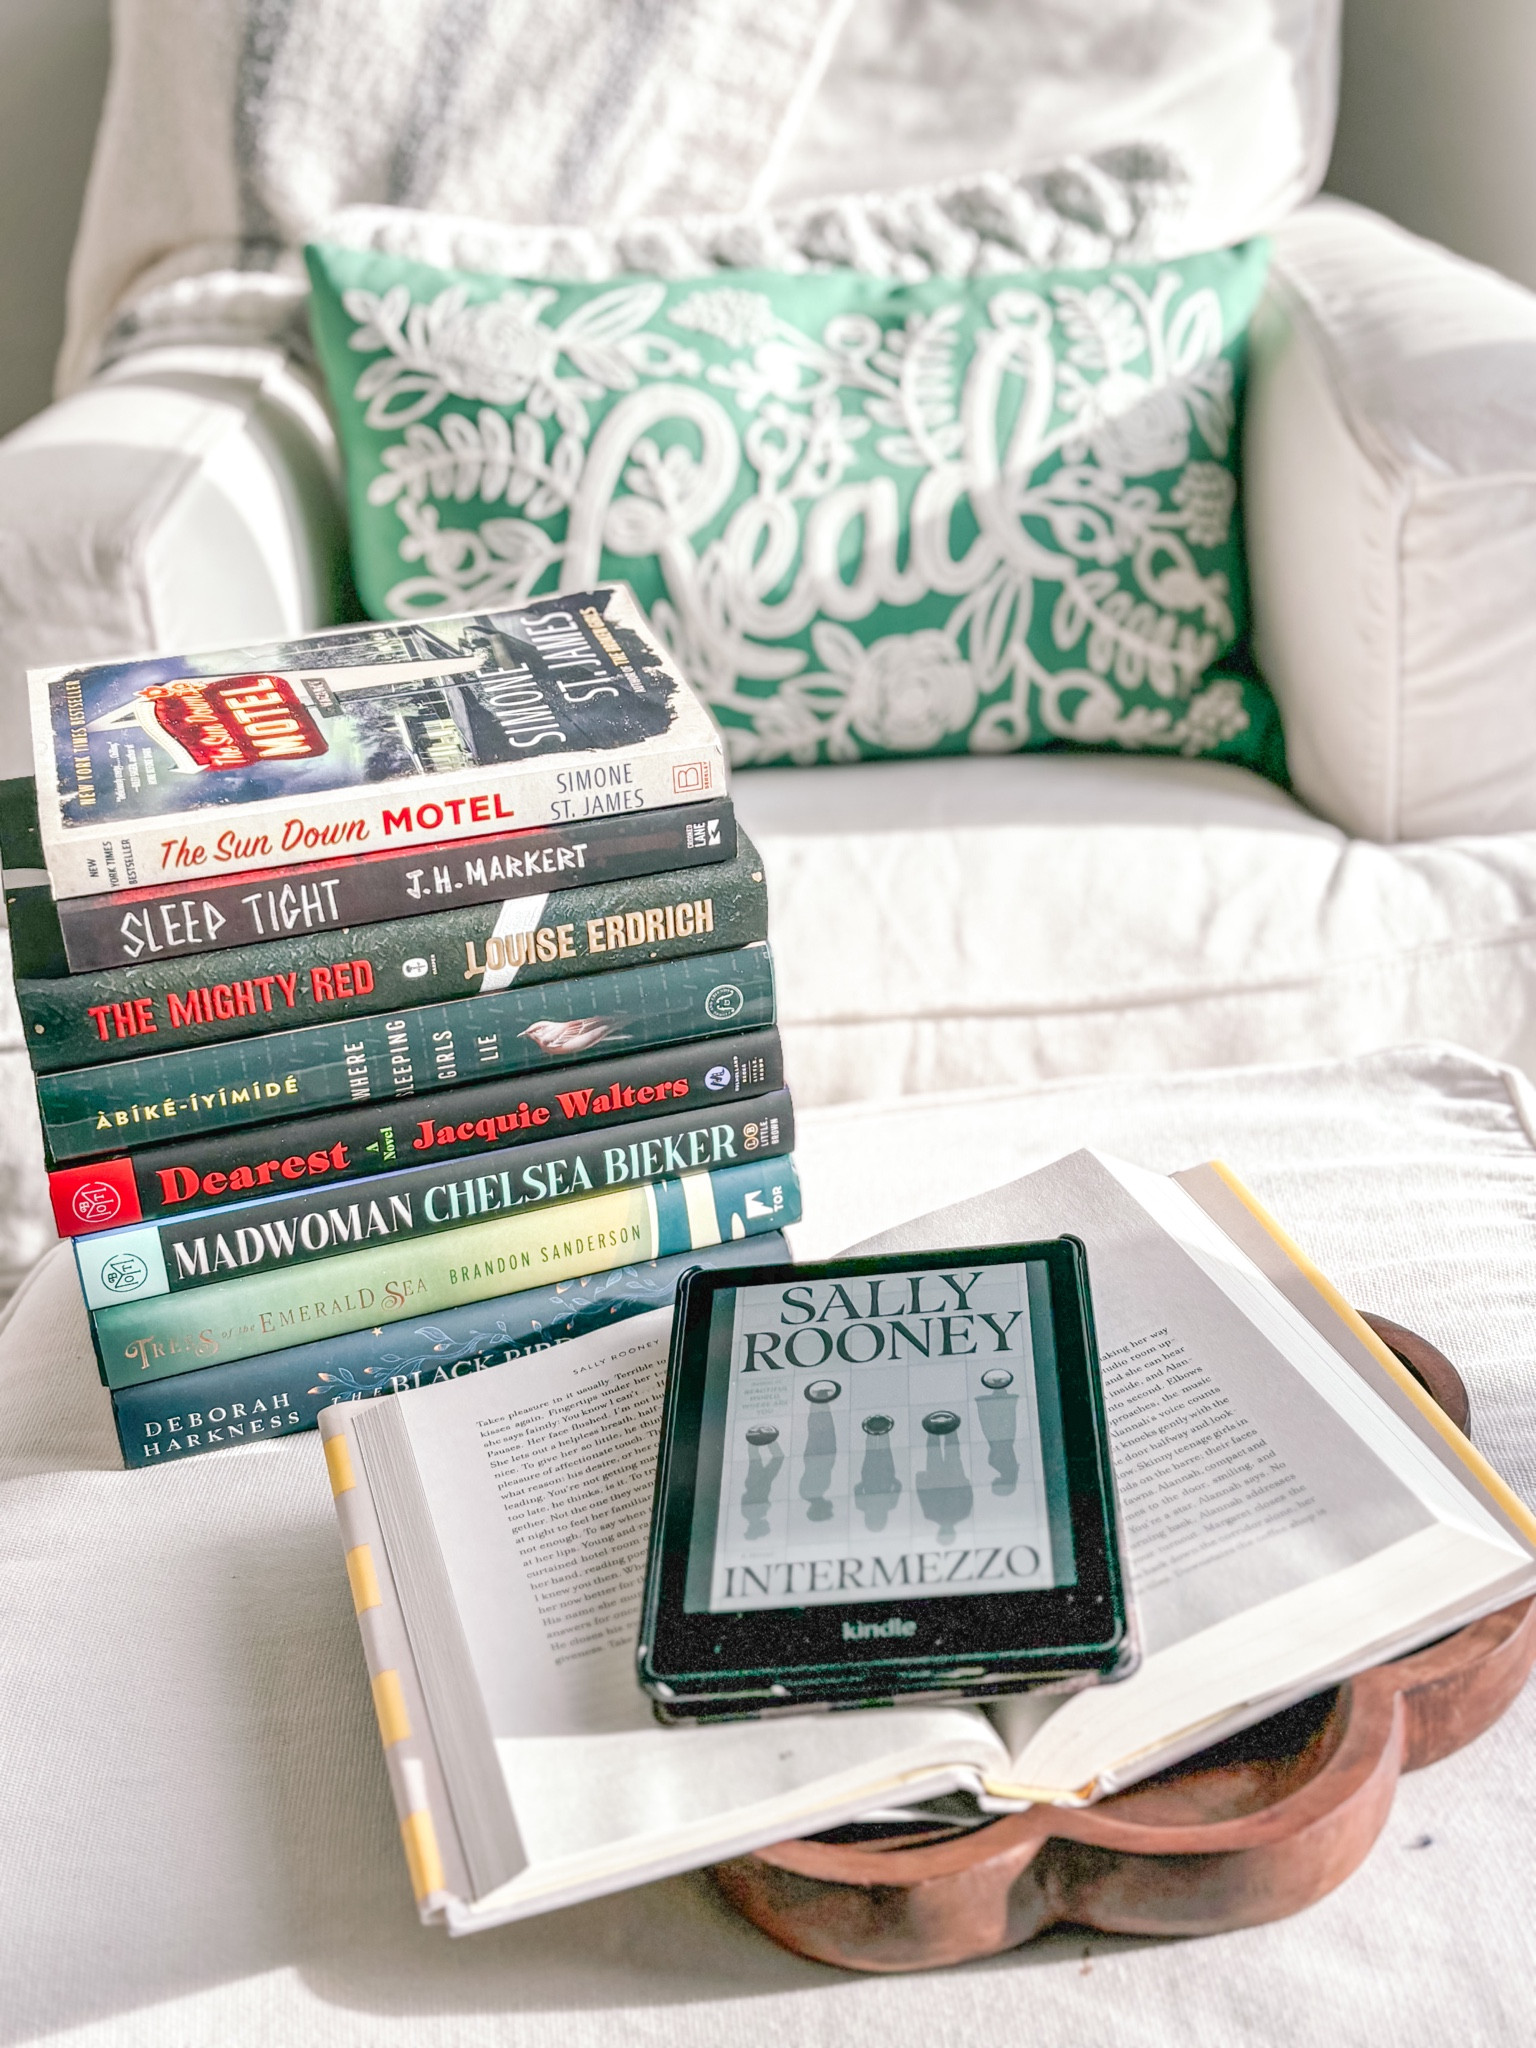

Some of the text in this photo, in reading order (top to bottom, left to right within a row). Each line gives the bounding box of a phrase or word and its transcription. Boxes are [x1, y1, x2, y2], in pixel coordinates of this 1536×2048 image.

[557, 325, 1080, 680] Read
[521, 611, 619, 703] ST. JAMES
[220, 677, 312, 758] MOTEL
[478, 662, 567, 748] SIMONE
[65, 679, 96, 806] NEW YORK TIMES BESTSELLER
[200, 723, 234, 746] Sun
[211, 745, 247, 766] The
[556, 763, 634, 794] SIMONE
[550, 788, 645, 821] ST. JAMES
[161, 793, 515, 869] The Sun Down MOTEL
[686, 824, 694, 849] CROOKED
[693, 822, 706, 848] LANE
[88, 858, 99, 878] NEW
[102, 841, 119, 888] YORK TIMES
[121, 838, 138, 885] BESTSELLER
[405, 843, 588, 899] J.H. MARKERT
[119, 878, 340, 959] SLEEP TIGHT
[464, 899, 715, 981] LOUISE ERDRICH
[88, 959, 375, 1042] THE MIGHTY RED
[433, 1030, 457, 1080] GIRLS
[478, 1033, 499, 1062] LIE
[344, 1041, 371, 1101] WHERE
[96, 1075, 299, 1130] ÀBÍKÉ-ÍYÍMÍDÉ
[413, 1102, 551, 1150] Jacquie
[555, 1077, 690, 1120] Walters
[365, 1141, 380, 1153] A
[379, 1126, 397, 1161] Novel
[759, 1117, 769, 1148] LITTLE,
[771, 1117, 780, 1145] BROWN
[156, 1140, 351, 1206] Dearest
[172, 1192, 414, 1280] MADWOMAN
[424, 1155, 593, 1224] CHELSEA
[603, 1124, 738, 1186] BIEKER
[773, 1185, 784, 1212] TOR
[222, 1329, 234, 1340] of
[238, 1323, 256, 1335] the
[258, 1286, 375, 1333] EMERALD
[381, 1278, 429, 1312] SEA
[449, 1251, 531, 1285] BRANDON
[540, 1224, 642, 1263] SANDERSON
[780, 1271, 985, 1325] SALLY
[572, 1339, 660, 1375] SALLY ROONEY
[740, 1310, 1024, 1373] ROONEY
[1129, 1327, 1167, 1347] her way
[1129, 1346, 1156, 1360] room
[331, 1386, 383, 1406] THE
[391, 1354, 494, 1393] BLACK
[1105, 1346, 1184, 1385] and she can hear
[1145, 1368, 1163, 1381] and
[1161, 1376, 1211, 1401] the music
[1165, 1366, 1202, 1385] Elbows
[144, 1392, 290, 1438] DEBORAH
[475, 1416, 505, 1427] Takes
[508, 1401, 548, 1420] pleasure
[613, 1363, 652, 1380] Terrible
[656, 1359, 669, 1368] to
[479, 1425, 510, 1437] kisses
[548, 1395, 597, 1416] Fingertips
[601, 1382, 629, 1396] under
[633, 1375, 650, 1384] her
[1158, 1387, 1220, 1417] voice counts
[143, 1411, 300, 1457] HARKNESS
[483, 1439, 501, 1447] she
[502, 1432, 523, 1442] says
[561, 1413, 579, 1422] You
[580, 1402, 607, 1415] know
[526, 1436, 545, 1445] Her
[548, 1428, 568, 1438] face
[633, 1398, 649, 1407] not
[1119, 1397, 1229, 1447] knocks gently with the
[489, 1459, 508, 1468] She
[510, 1453, 529, 1461] lets
[531, 1446, 547, 1455] out
[558, 1429, 598, 1447] helpless
[497, 1472, 540, 1491] pleasure
[542, 1466, 552, 1475] of
[554, 1447, 612, 1471] affectionate
[537, 1455, 557, 1467] give
[560, 1448, 577, 1458] her
[623, 1426, 636, 1434] he
[724, 1545, 1041, 1599] INTERMEZZO
[842, 1617, 918, 1642] kindle
